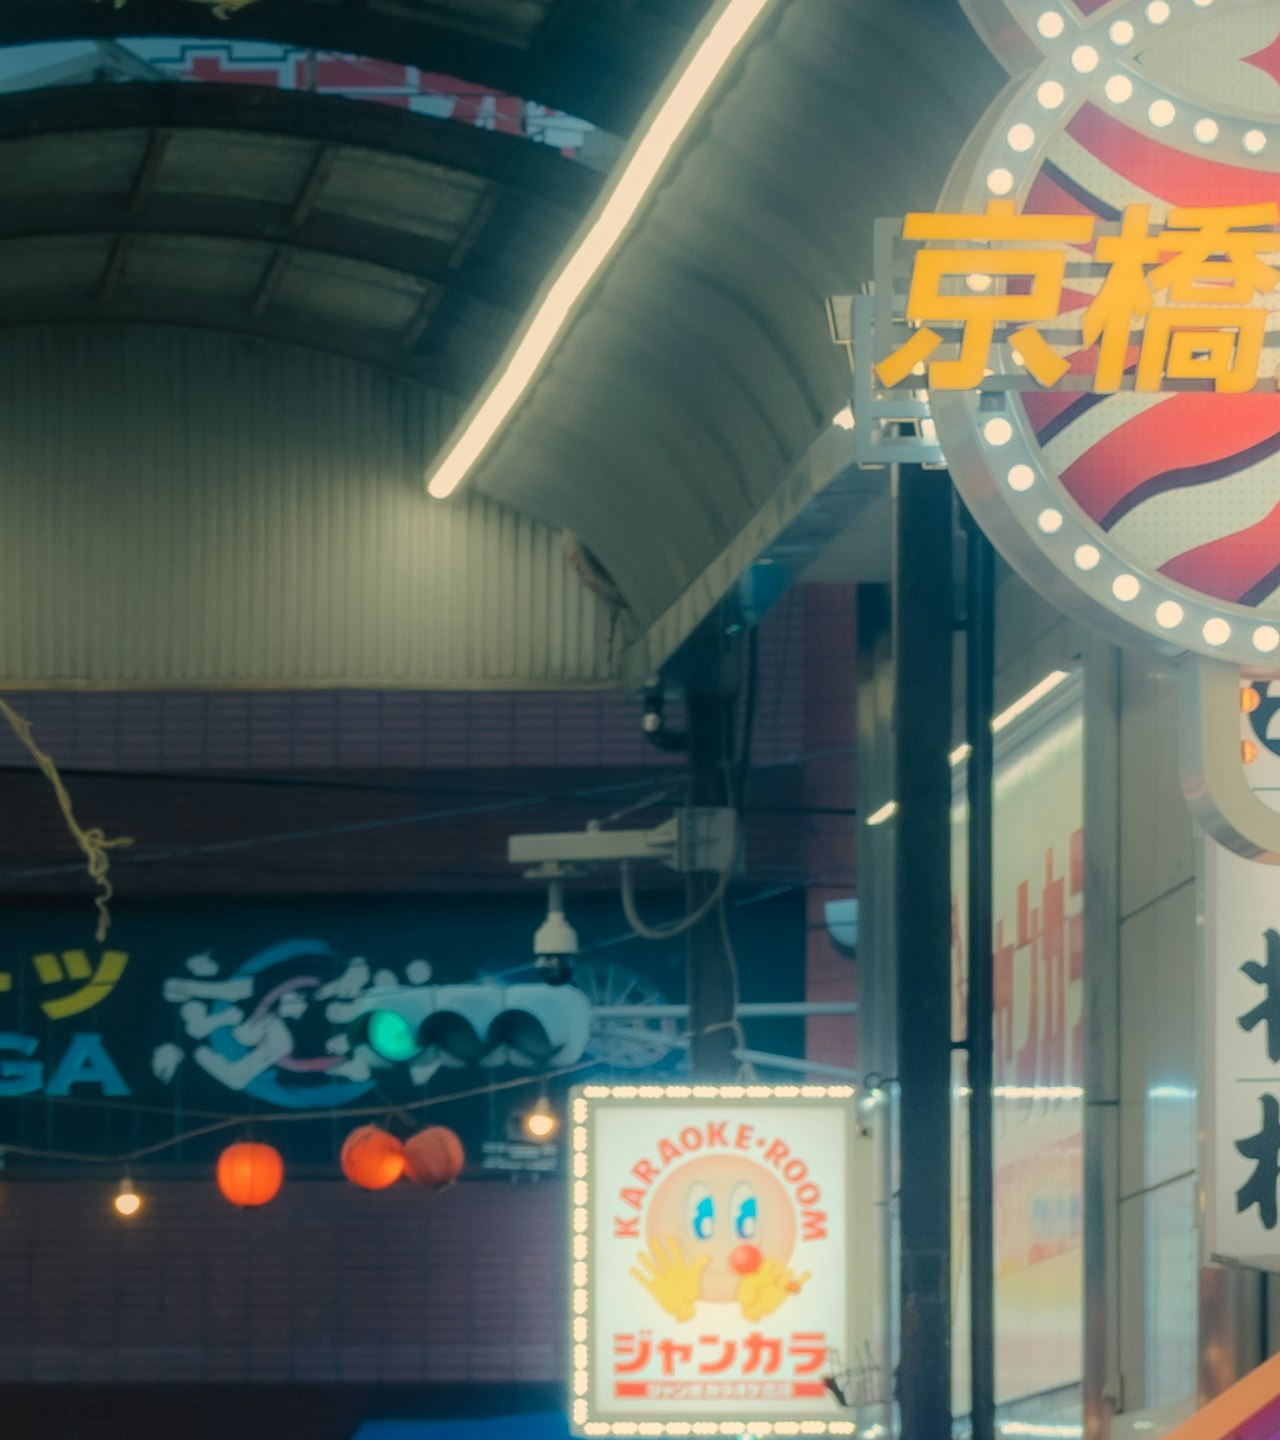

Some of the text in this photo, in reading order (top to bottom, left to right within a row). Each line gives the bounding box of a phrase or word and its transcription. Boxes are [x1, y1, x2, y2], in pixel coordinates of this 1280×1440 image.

[613, 1329, 828, 1376] ジャンカラ
